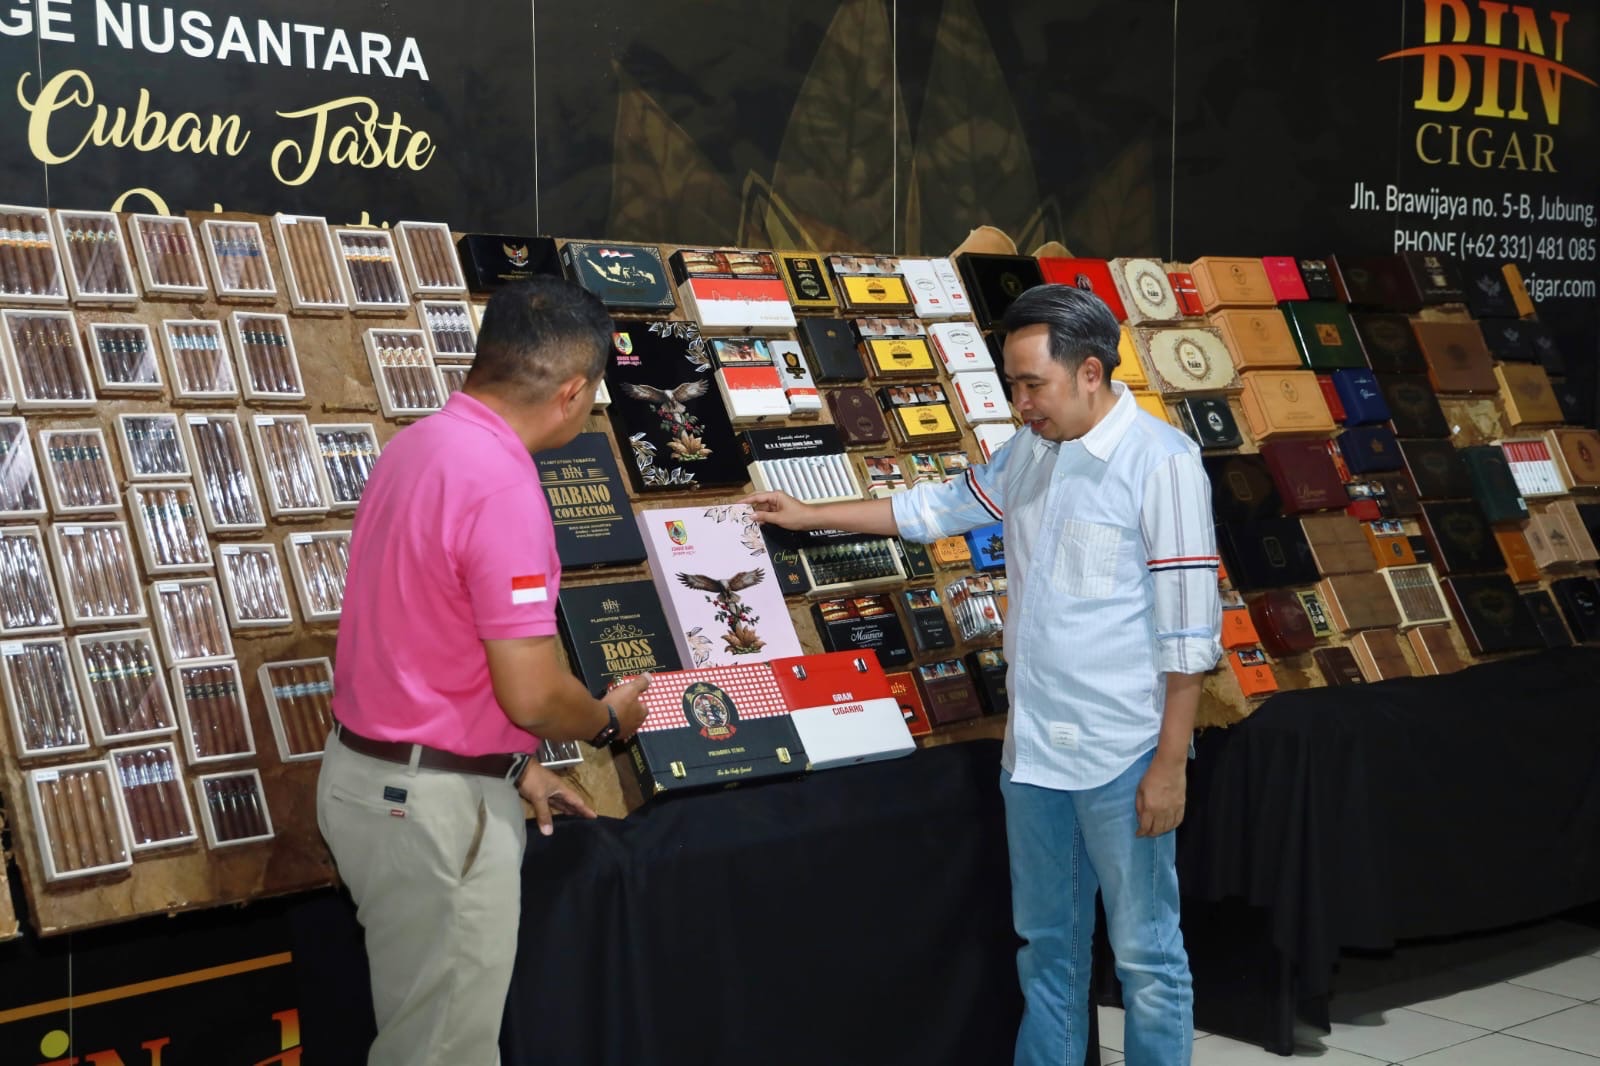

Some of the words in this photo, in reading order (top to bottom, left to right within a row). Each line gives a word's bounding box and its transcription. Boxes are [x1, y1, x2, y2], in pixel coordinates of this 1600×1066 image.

[96, 0, 430, 81] NUSANTARA
[1414, 0, 1572, 126] BIN
[16, 69, 250, 165] Cuban
[271, 96, 436, 186] Taste
[1415, 122, 1558, 173] CIGAR
[1350, 182, 1380, 211] Jln.
[1386, 184, 1468, 220] Brawijaya
[1473, 197, 1498, 217] no.
[1502, 193, 1535, 223] 5-B,
[1538, 196, 1598, 227] Jubung,
[1460, 233, 1495, 261] (+62
[1500, 235, 1534, 261] 331)
[1537, 236, 1565, 261] 481
[1568, 238, 1597, 262] 085
[547, 484, 611, 506] HABANO
[555, 503, 616, 519] COLECCIÓN
[601, 638, 653, 660] BOSS
[606, 655, 657, 672] COLLECTIONS
[832, 692, 854, 702] GRAN
[832, 704, 864, 715] CIGARRO
